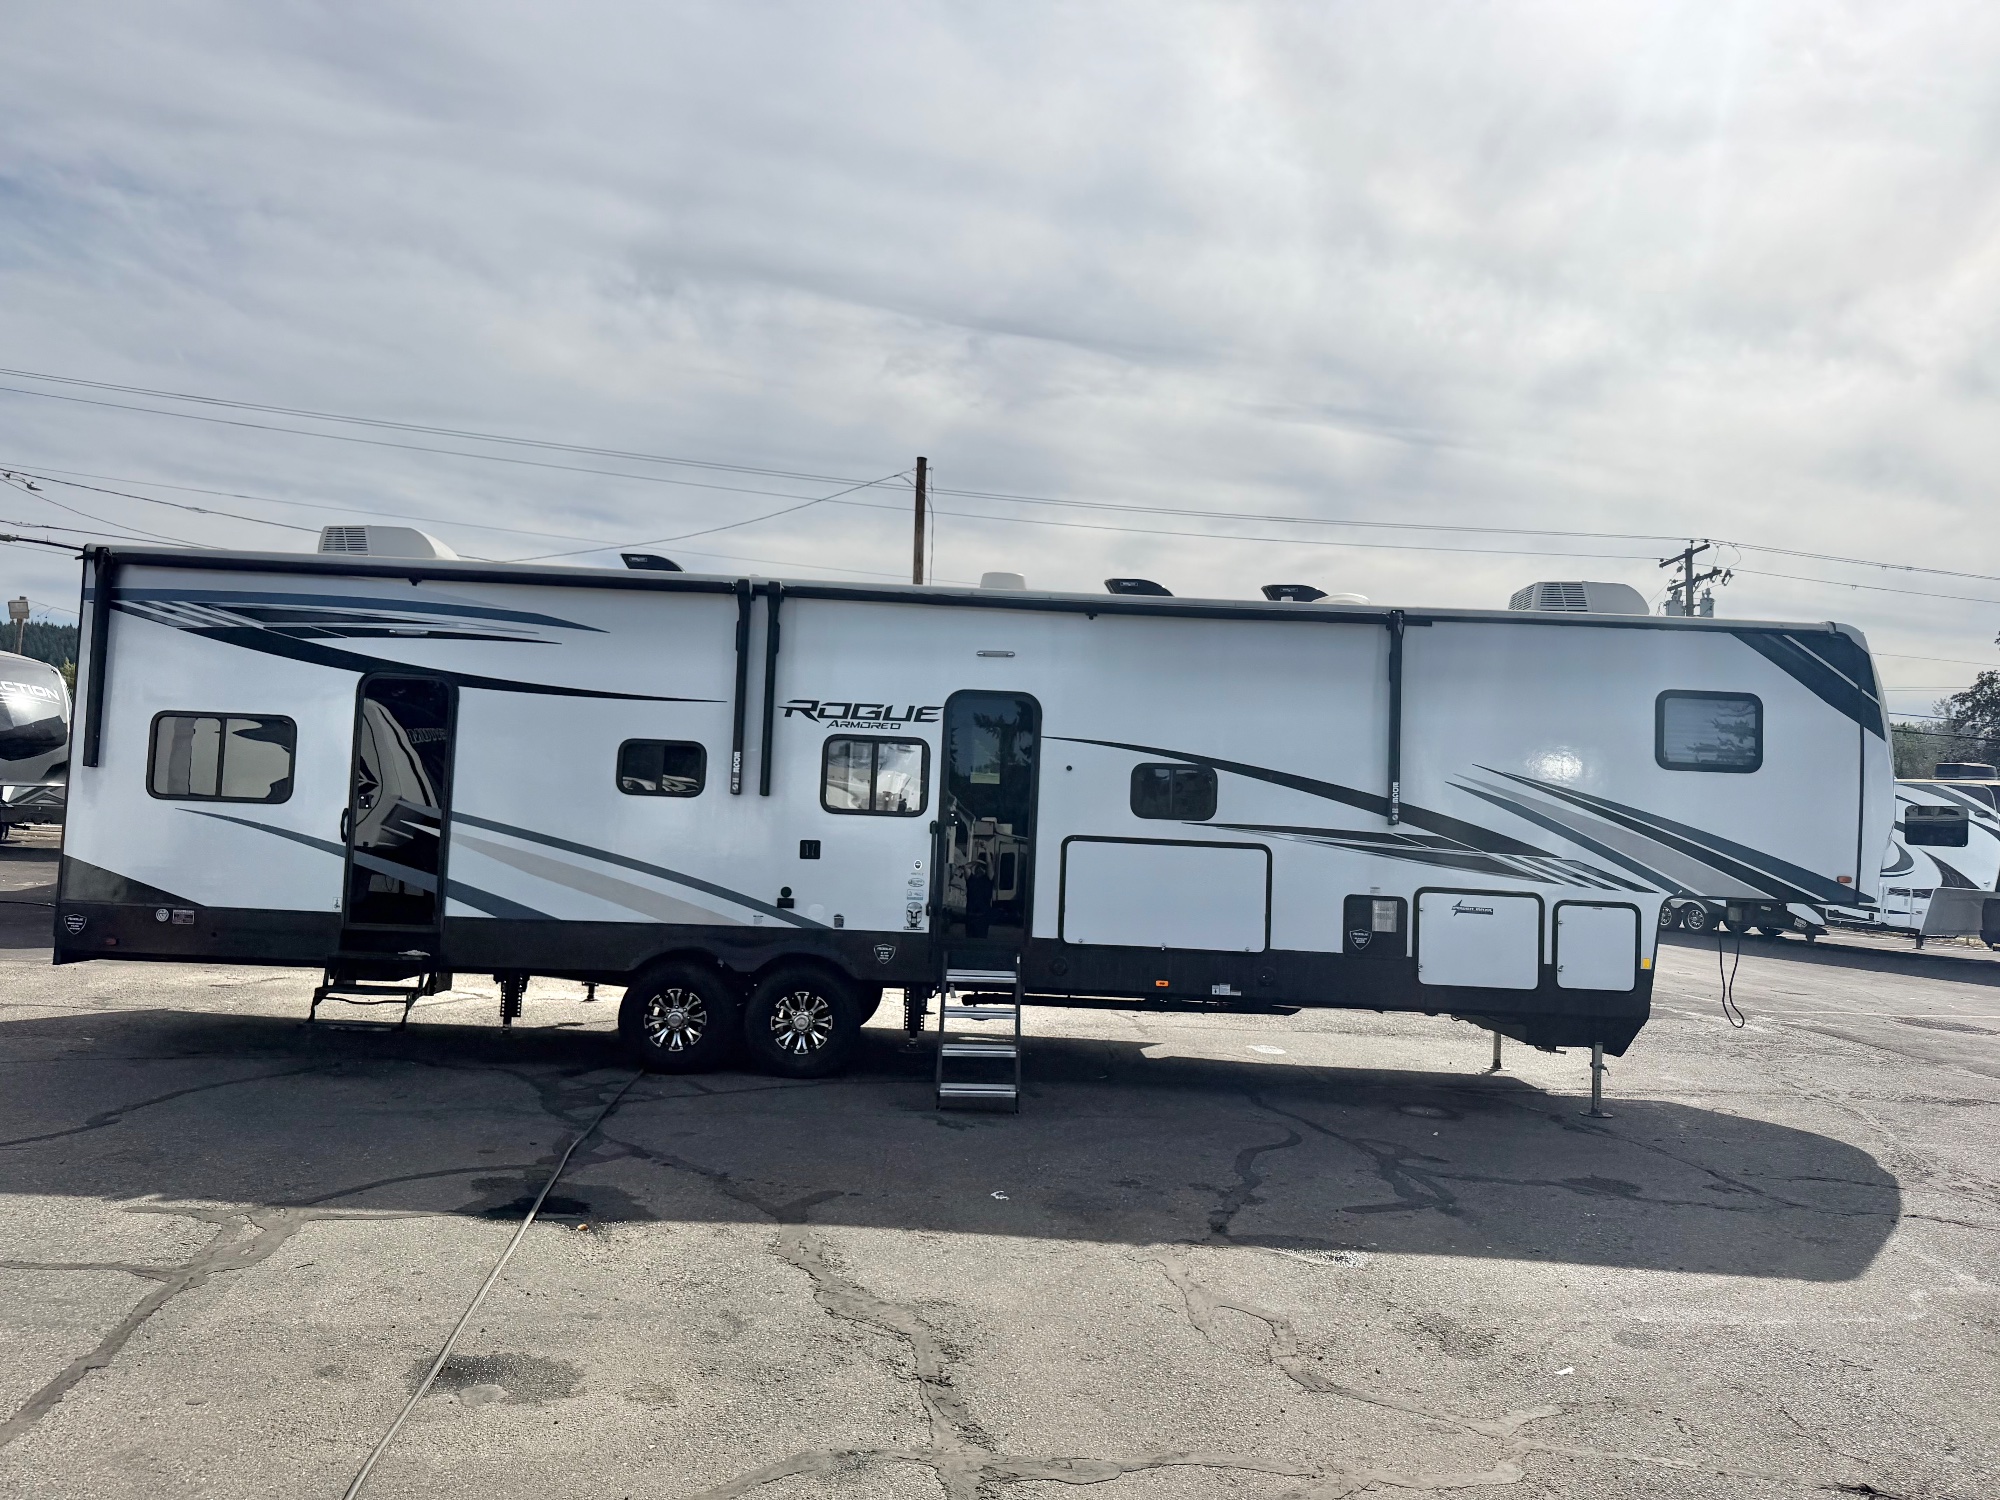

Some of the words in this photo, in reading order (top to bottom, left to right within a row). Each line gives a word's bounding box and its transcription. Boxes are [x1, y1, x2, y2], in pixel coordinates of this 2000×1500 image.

[0, 681, 60, 700] CTION
[777, 700, 944, 723] ROGUE
[827, 720, 901, 730] ARMORED
